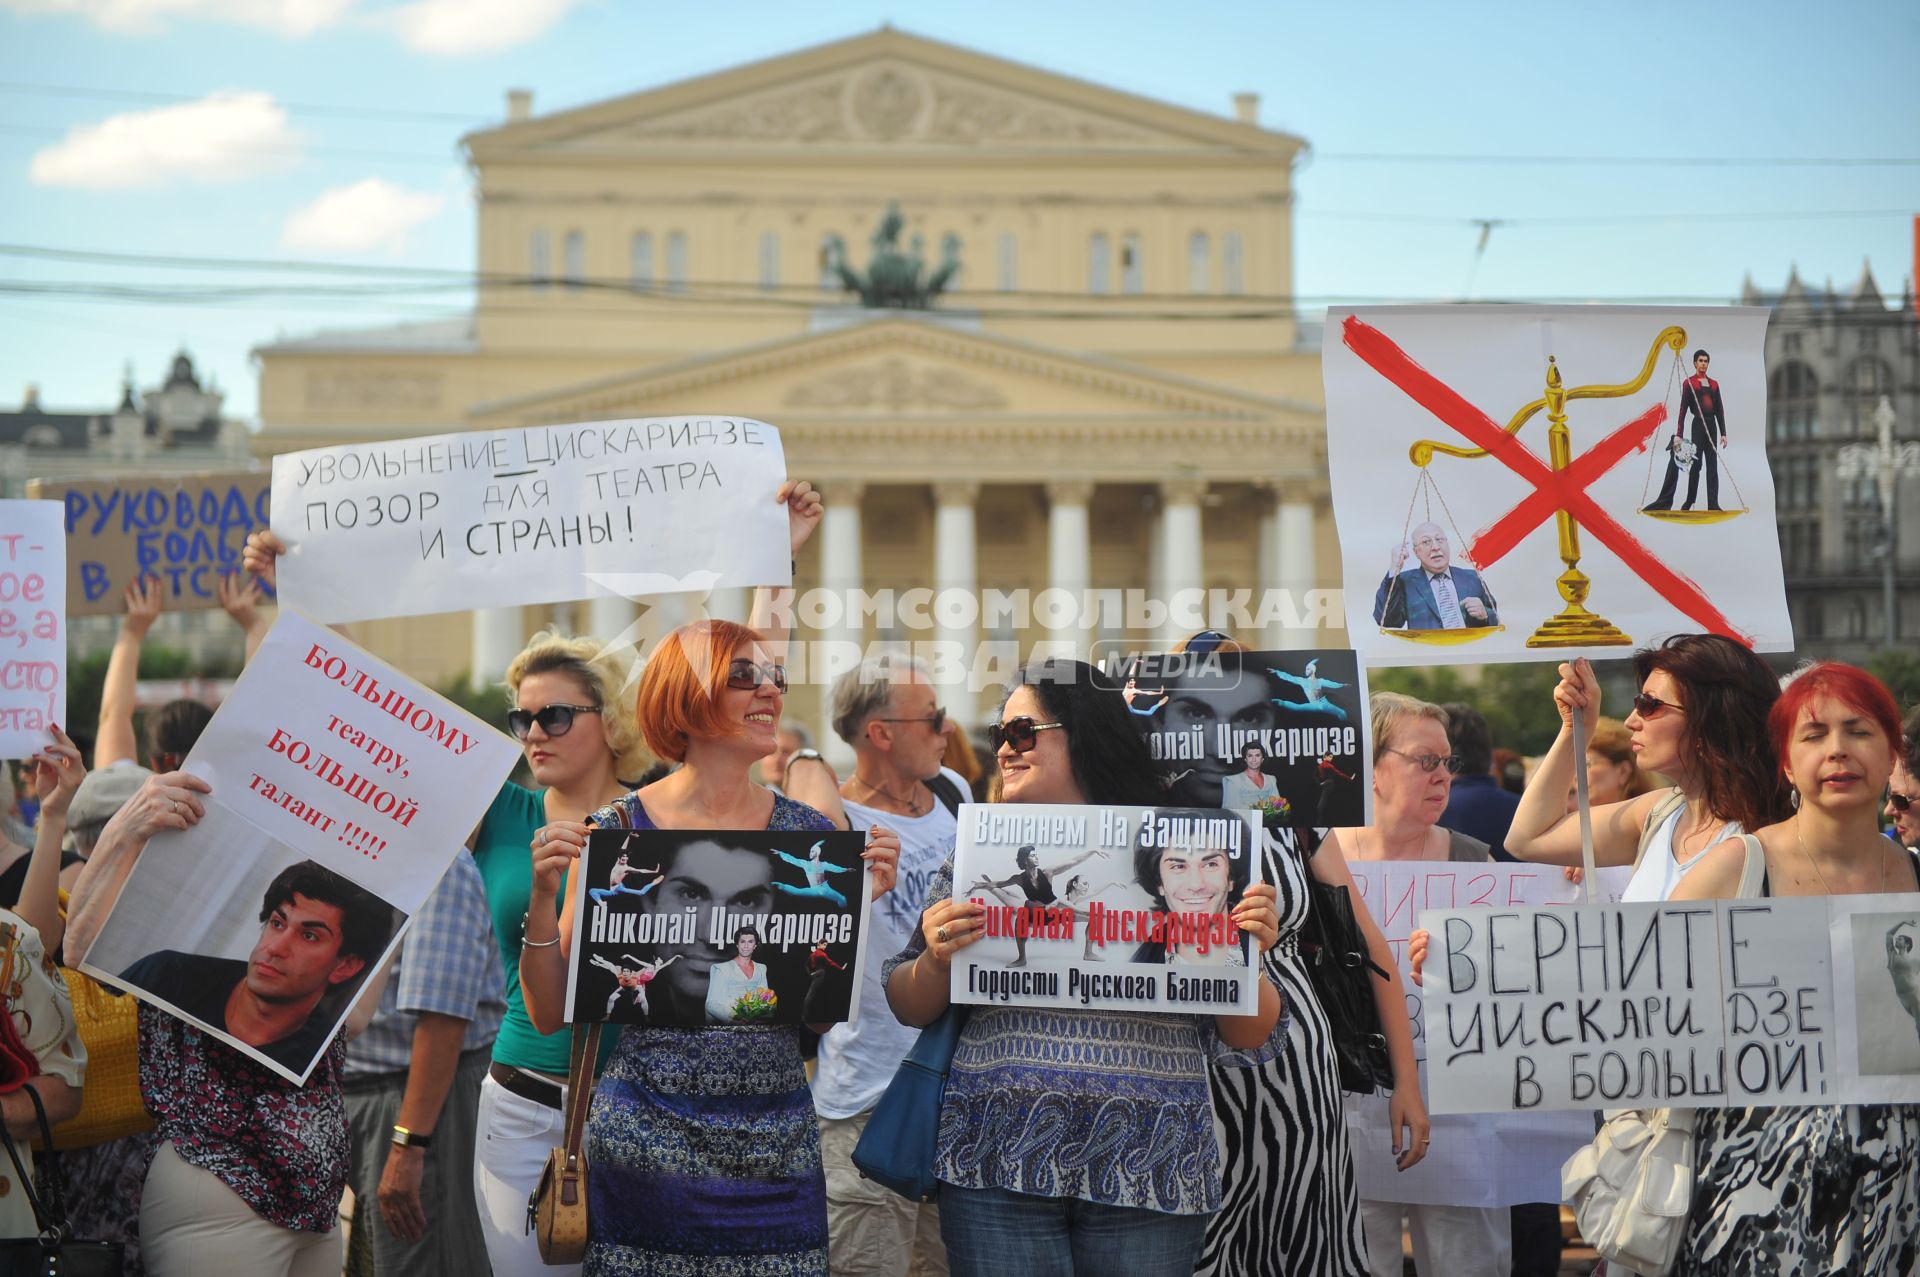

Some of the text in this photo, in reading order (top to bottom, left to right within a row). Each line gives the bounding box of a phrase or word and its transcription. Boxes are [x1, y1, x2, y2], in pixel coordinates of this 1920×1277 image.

[297, 421, 765, 488] УВОЛЬНЕНИЕ ЦИСКАРИДЗЕ
[305, 460, 722, 531] ПОЗОР ДЛЯ ТЕАТРА
[137, 530, 249, 565] БОЛЬ
[419, 528, 445, 560] И
[81, 561, 110, 602] В
[303, 643, 480, 756] БОЛЬШОМУ
[326, 713, 410, 779] театру,
[248, 772, 337, 834] талант
[265, 727, 420, 828] БОЛЬШОЙ
[974, 807, 1086, 846] Встанем
[1099, 809, 1129, 847] На
[1140, 809, 1243, 860] Защиту
[590, 904, 698, 945] Николай
[1088, 901, 1240, 955] Цискаридзе
[1445, 906, 1779, 996] ВЕРНИТЕ
[968, 964, 1240, 1005] Гордости Русского Балета
[1512, 1039, 1827, 1109] В БОЛЬШОЙ!
